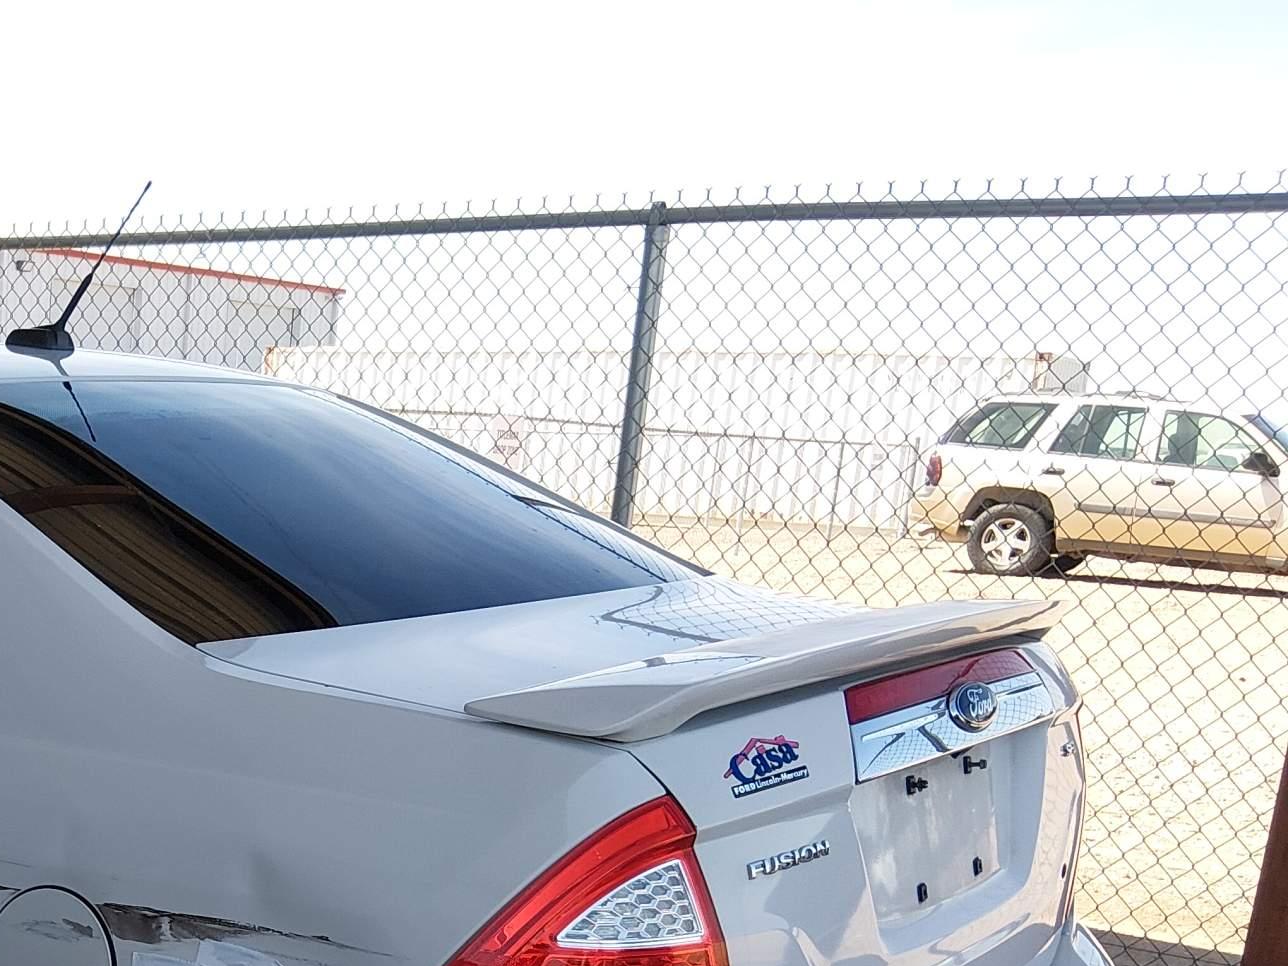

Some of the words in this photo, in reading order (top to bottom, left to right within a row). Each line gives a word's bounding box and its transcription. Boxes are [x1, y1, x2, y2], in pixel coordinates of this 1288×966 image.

[966, 688, 992, 718] Ford
[730, 743, 799, 784] Casa
[733, 782, 757, 796] FORD
[756, 768, 808, 789] Lincoln-Mercury
[746, 840, 830, 880] FUSION
